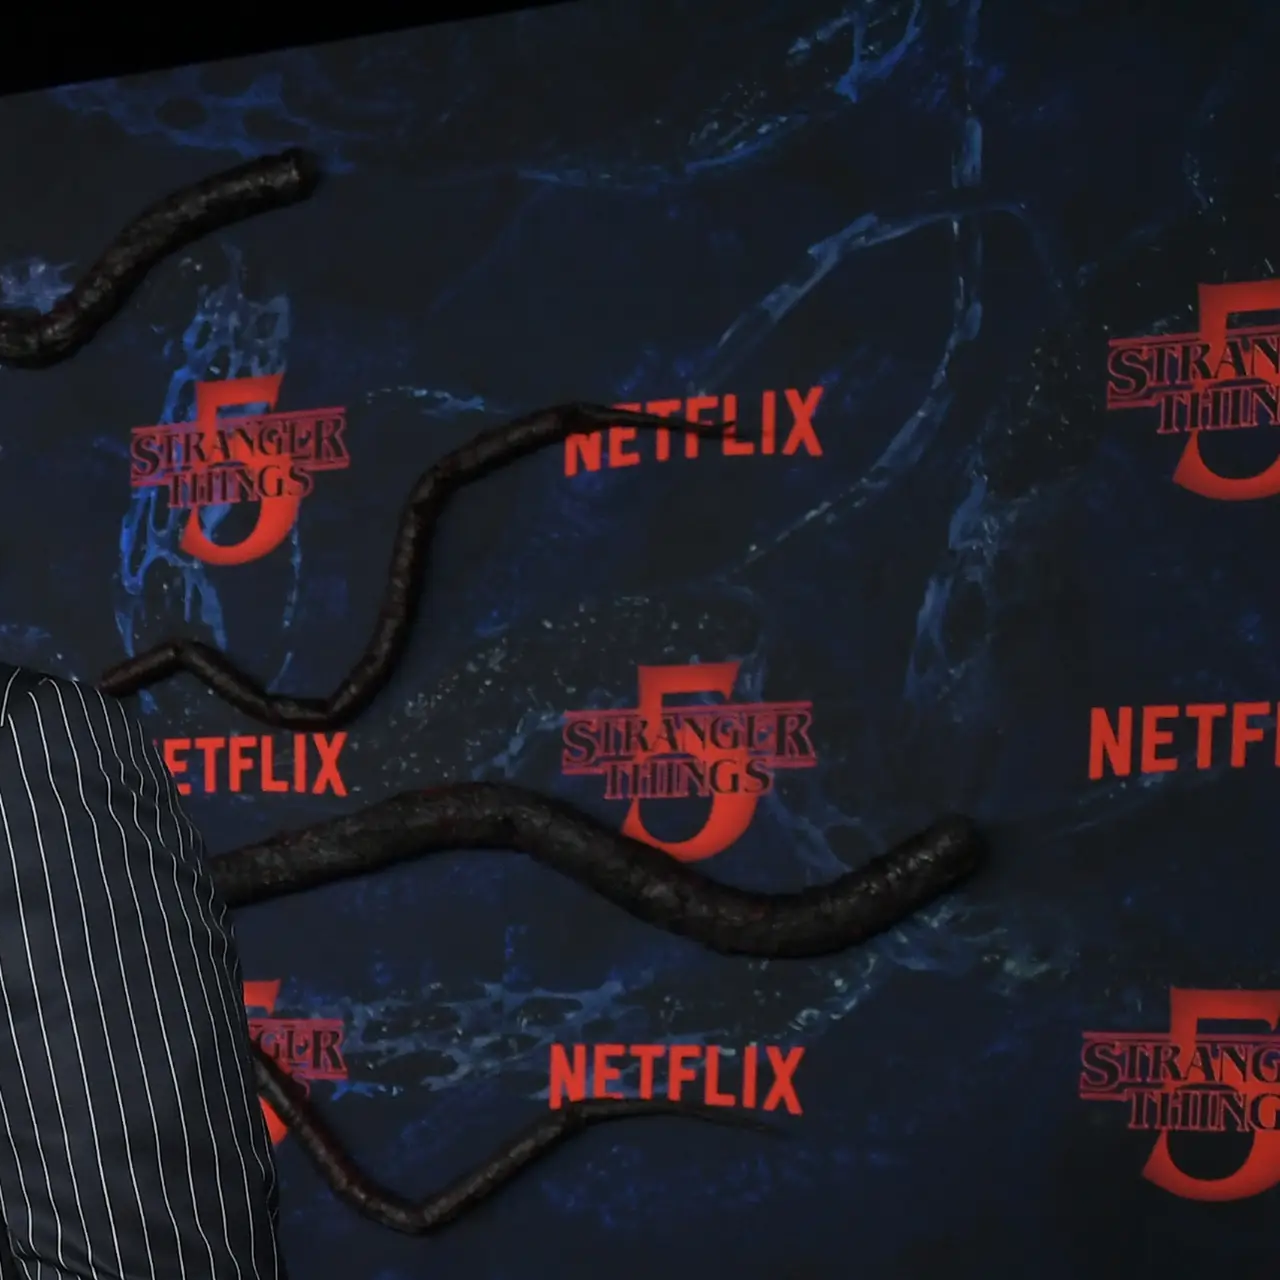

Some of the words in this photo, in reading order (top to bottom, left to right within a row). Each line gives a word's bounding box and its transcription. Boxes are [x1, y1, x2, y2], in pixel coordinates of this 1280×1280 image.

[1173, 278, 1280, 501] 5
[130, 413, 349, 479] STRANGER
[180, 373, 301, 565] 5
[564, 386, 823, 478] NETFLIX
[167, 465, 314, 508] THINGS
[152, 731, 348, 796] ETFLIX
[562, 709, 817, 766] STRANGER
[620, 661, 758, 863] 5
[1088, 701, 1280, 780] NETF
[603, 757, 774, 800] THINGS
[548, 1043, 806, 1116] NETFLIX
[1141, 984, 1280, 1201] 5
